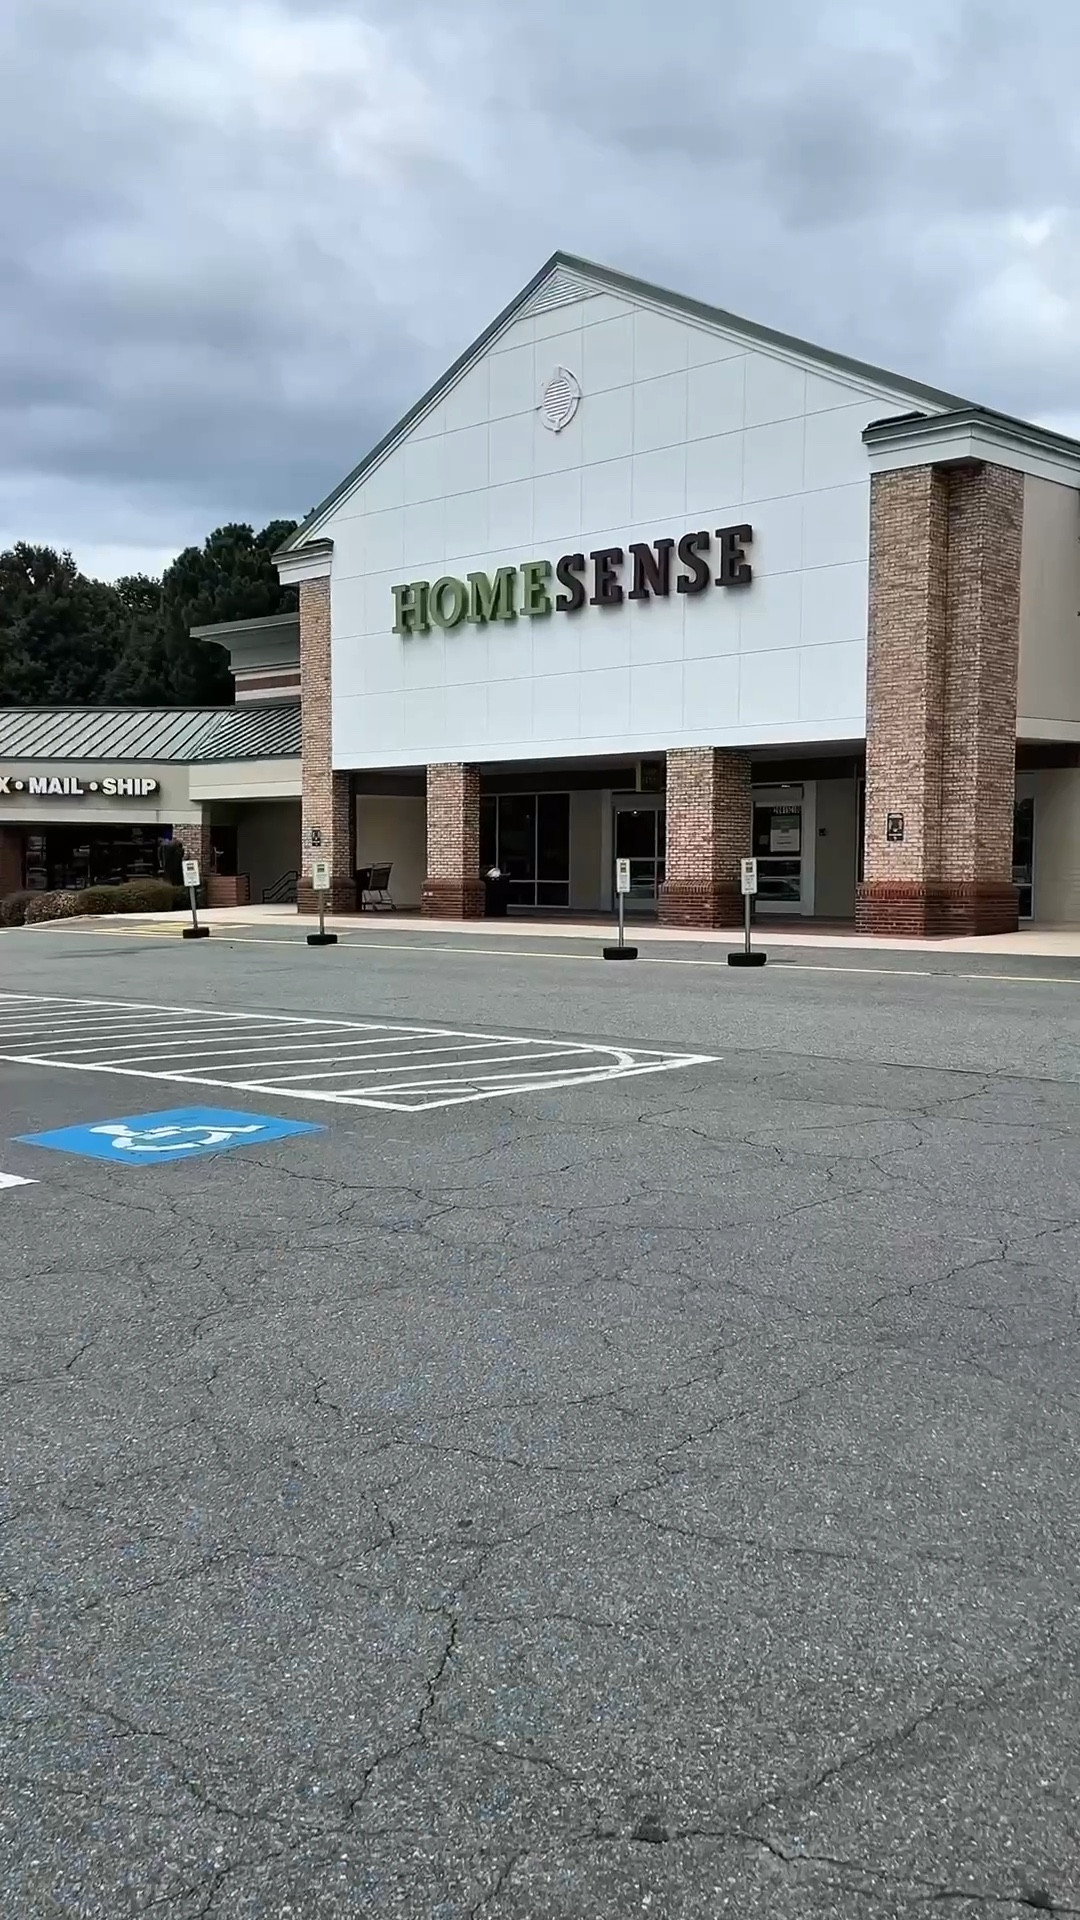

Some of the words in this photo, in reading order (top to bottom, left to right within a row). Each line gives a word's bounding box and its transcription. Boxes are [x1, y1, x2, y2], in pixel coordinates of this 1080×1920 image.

[391, 524, 753, 634] HOMESENSE
[28, 776, 84, 795] MAIL
[102, 777, 157, 796] SHIP
